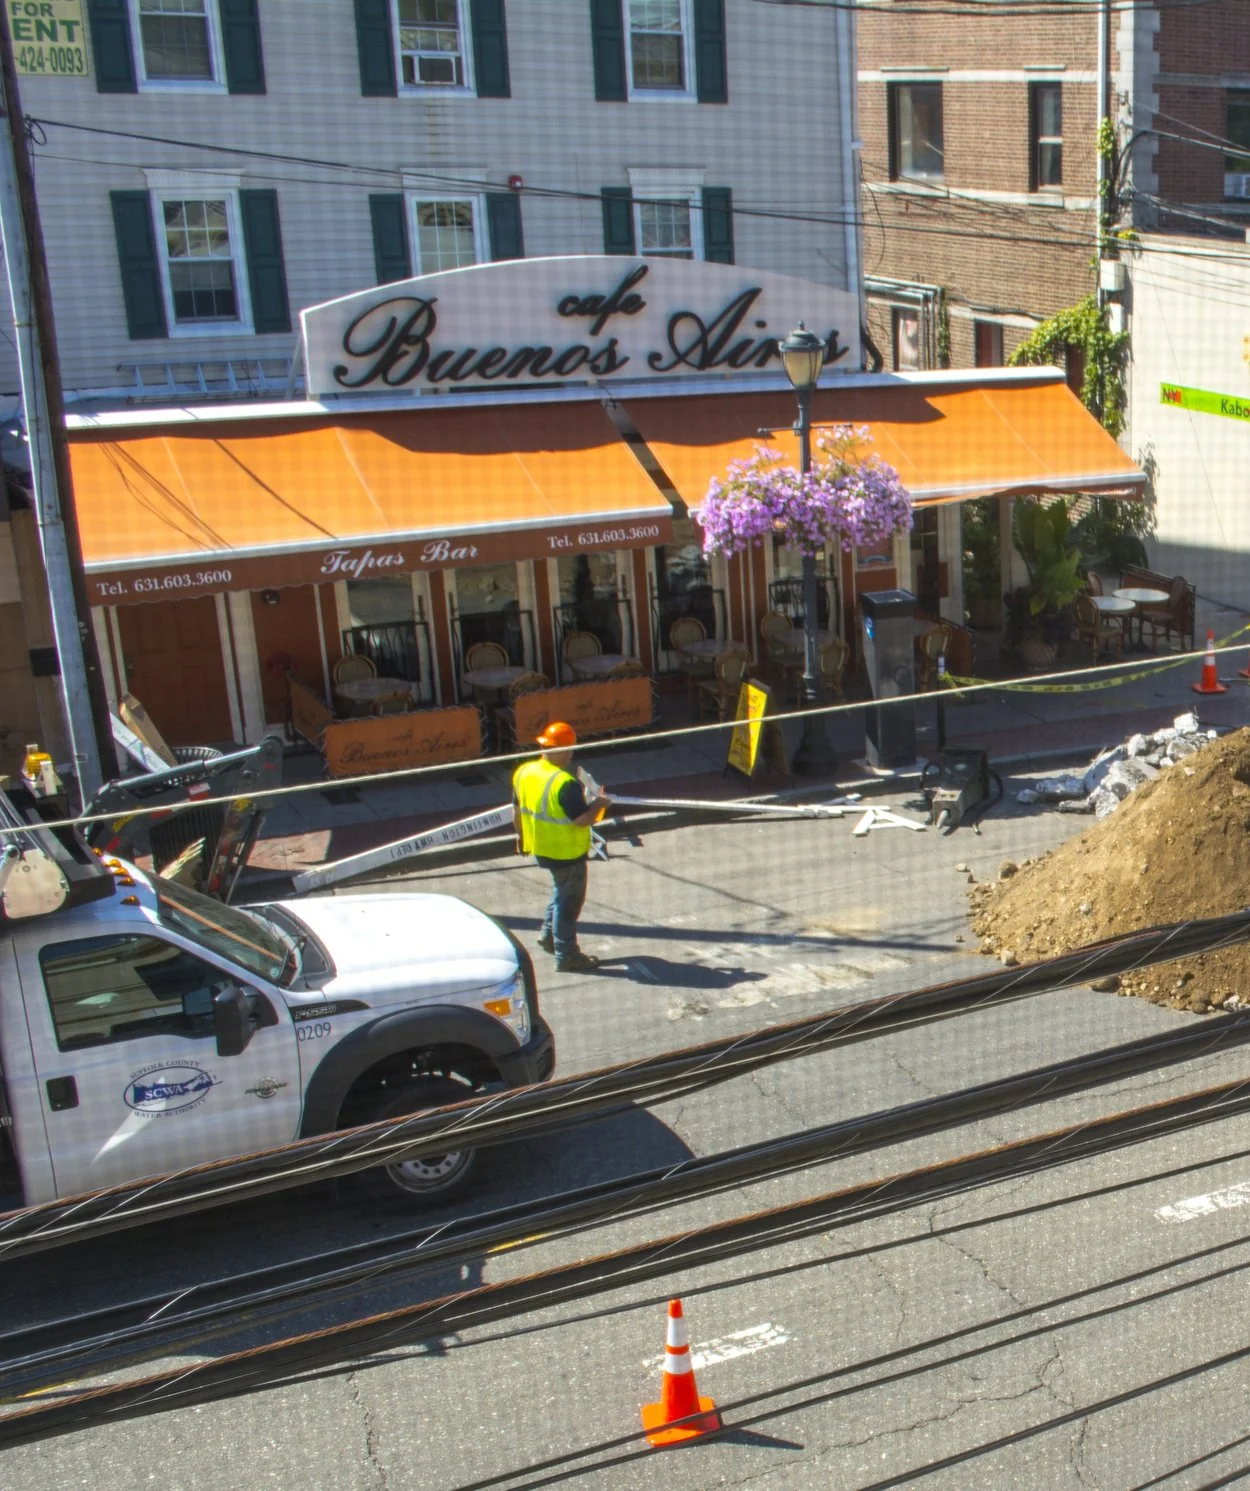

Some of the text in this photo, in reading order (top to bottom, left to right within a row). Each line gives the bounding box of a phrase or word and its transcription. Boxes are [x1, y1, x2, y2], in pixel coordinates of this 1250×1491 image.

[11, 2, 54, 17] FOR
[12, 18, 80, 42] ENT
[15, 46, 83, 72] -424-0093
[557, 265, 649, 336] cafe
[333, 287, 850, 388] Buenos Airs
[547, 525, 659, 548] Tel. 631.603.3600
[320, 539, 479, 578] Tapas Bar
[96, 570, 232, 596] Tel. 631.603.3600
[297, 1022, 331, 1042] 0209
[166, 1059, 200, 1068] COUNTY
[145, 1085, 184, 1099] SCWA
